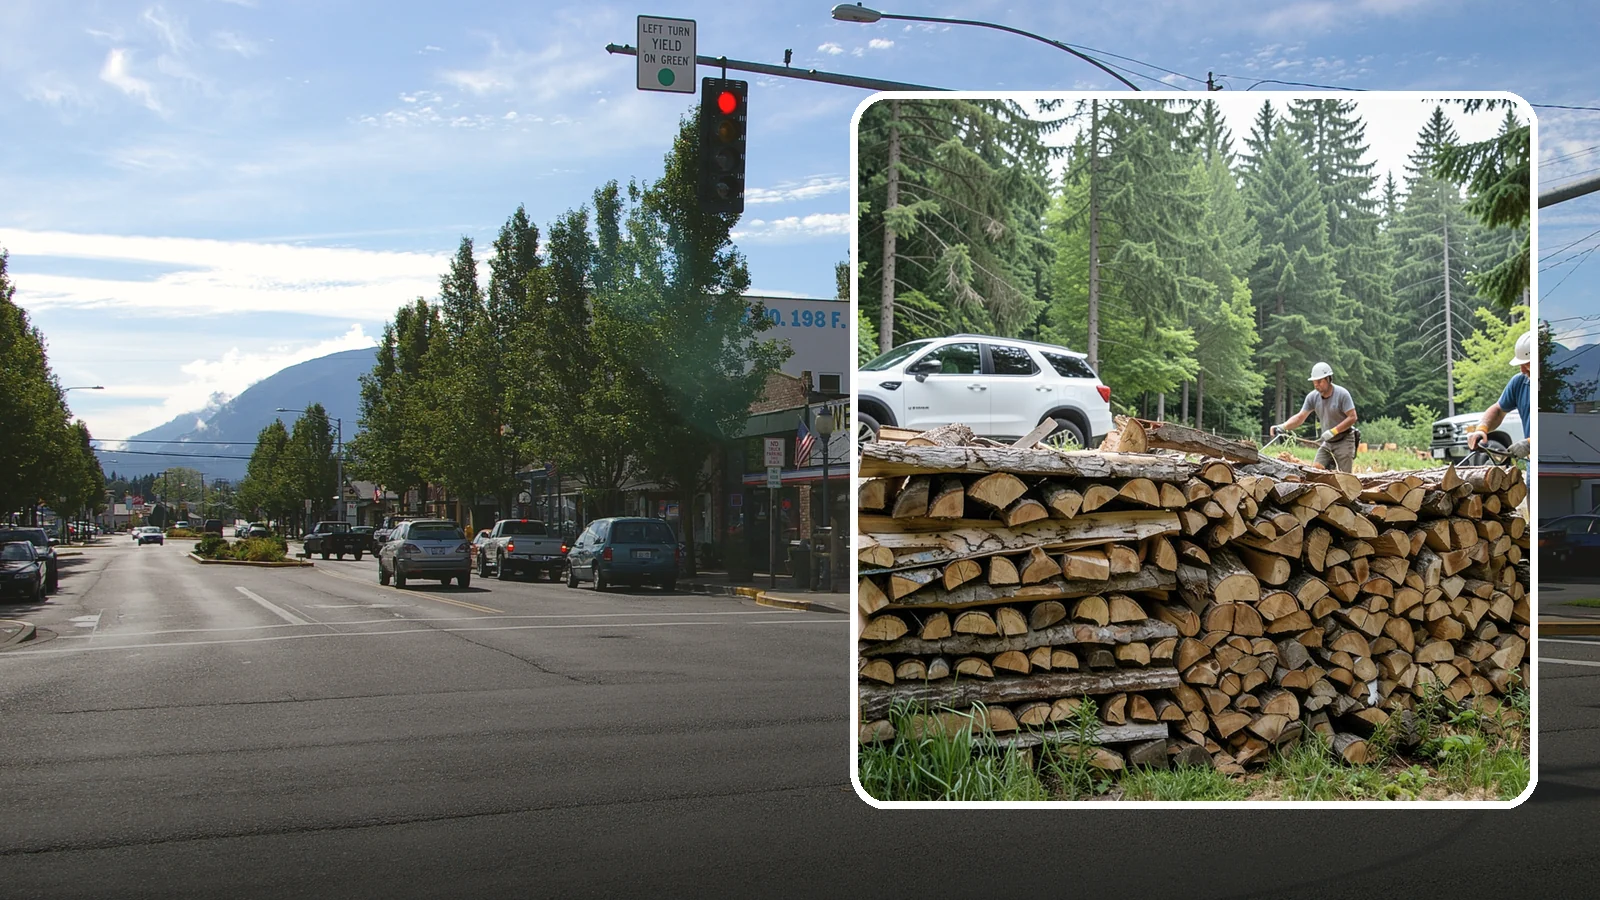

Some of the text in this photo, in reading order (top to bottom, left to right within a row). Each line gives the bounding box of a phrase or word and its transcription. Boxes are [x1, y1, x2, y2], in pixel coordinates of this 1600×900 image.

[643, 24, 690, 36] LEFT TURN
[652, 38, 682, 51] YIELD
[644, 54, 689, 66] ON GREEN
[791, 309, 827, 328] 198
[831, 311, 846, 329] F.
